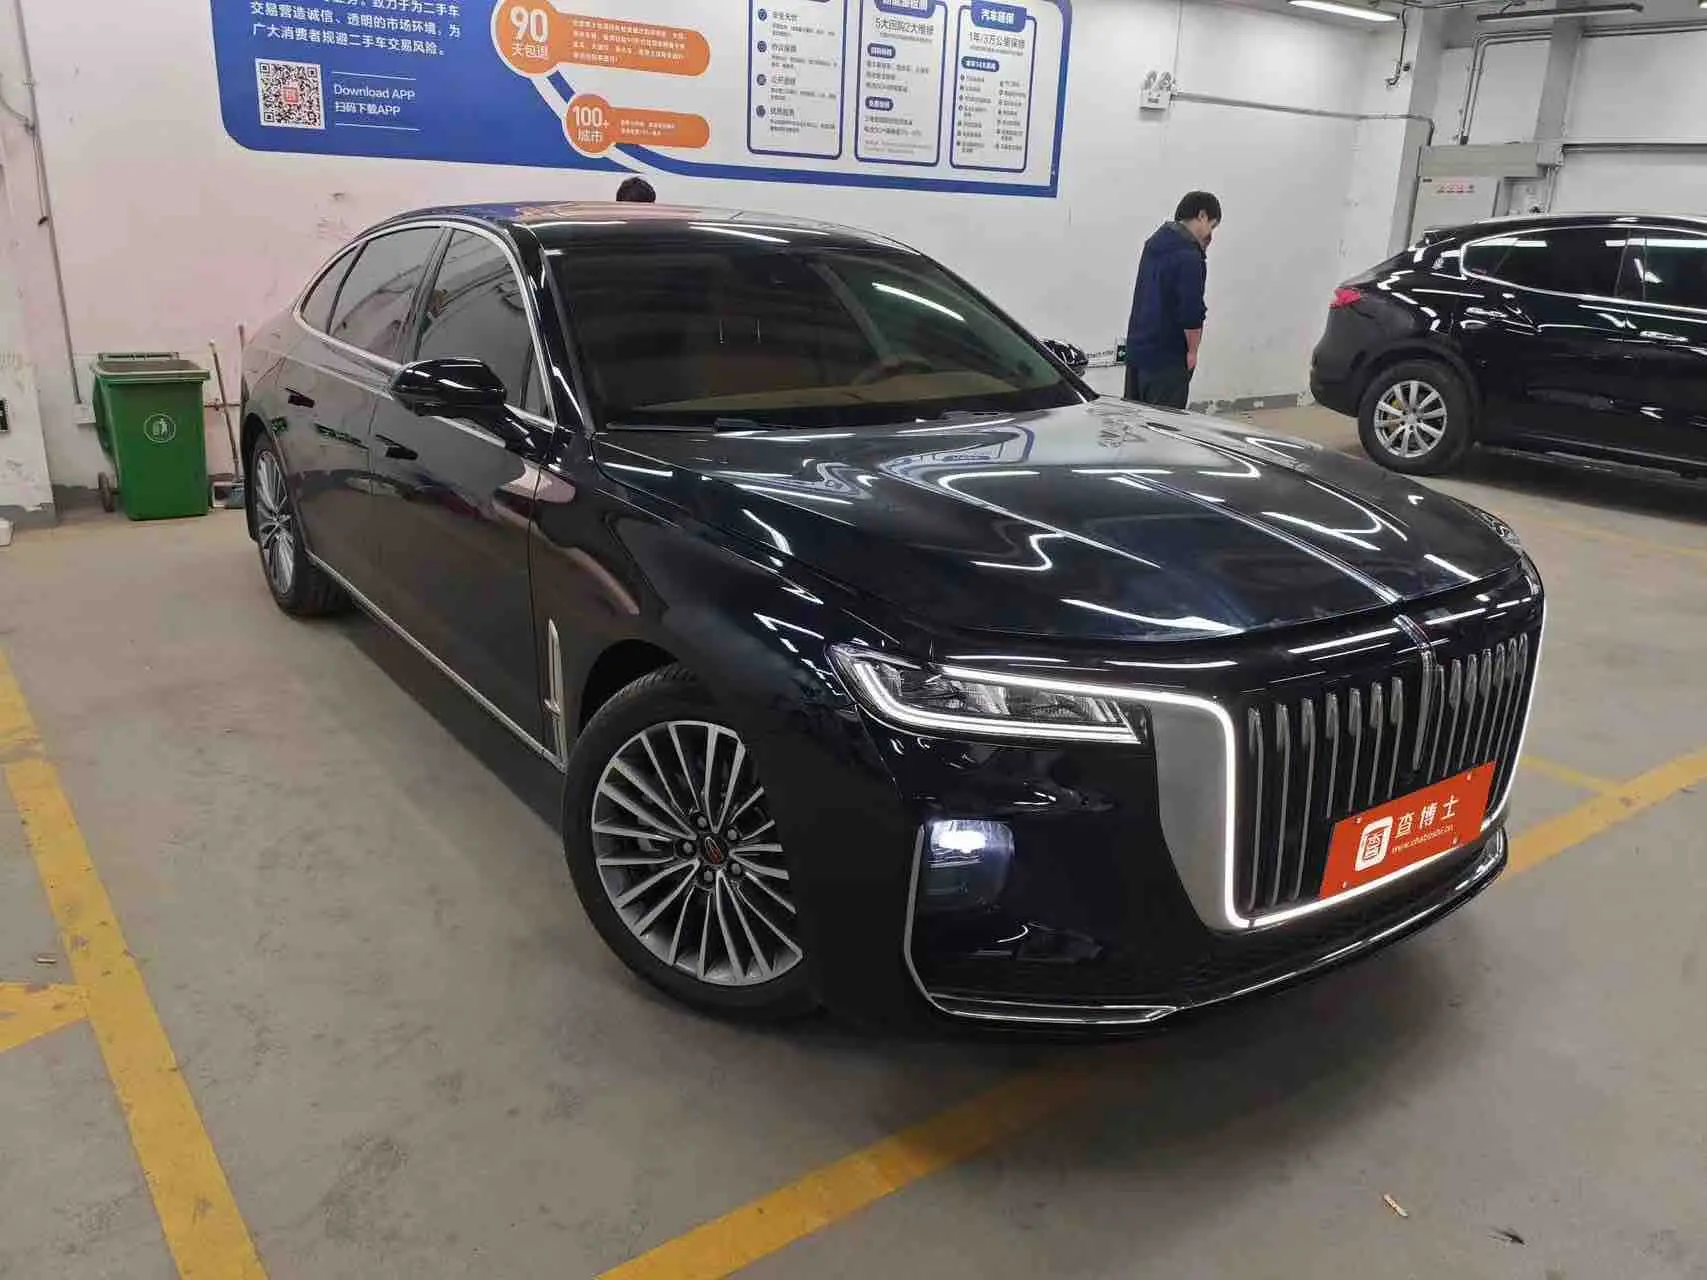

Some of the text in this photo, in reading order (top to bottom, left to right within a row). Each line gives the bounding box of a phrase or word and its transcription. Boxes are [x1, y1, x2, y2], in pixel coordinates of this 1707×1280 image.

[511, 5, 548, 42] 90
[334, 83, 416, 100] Download APP
[335, 101, 401, 115] 扫码下载APP
